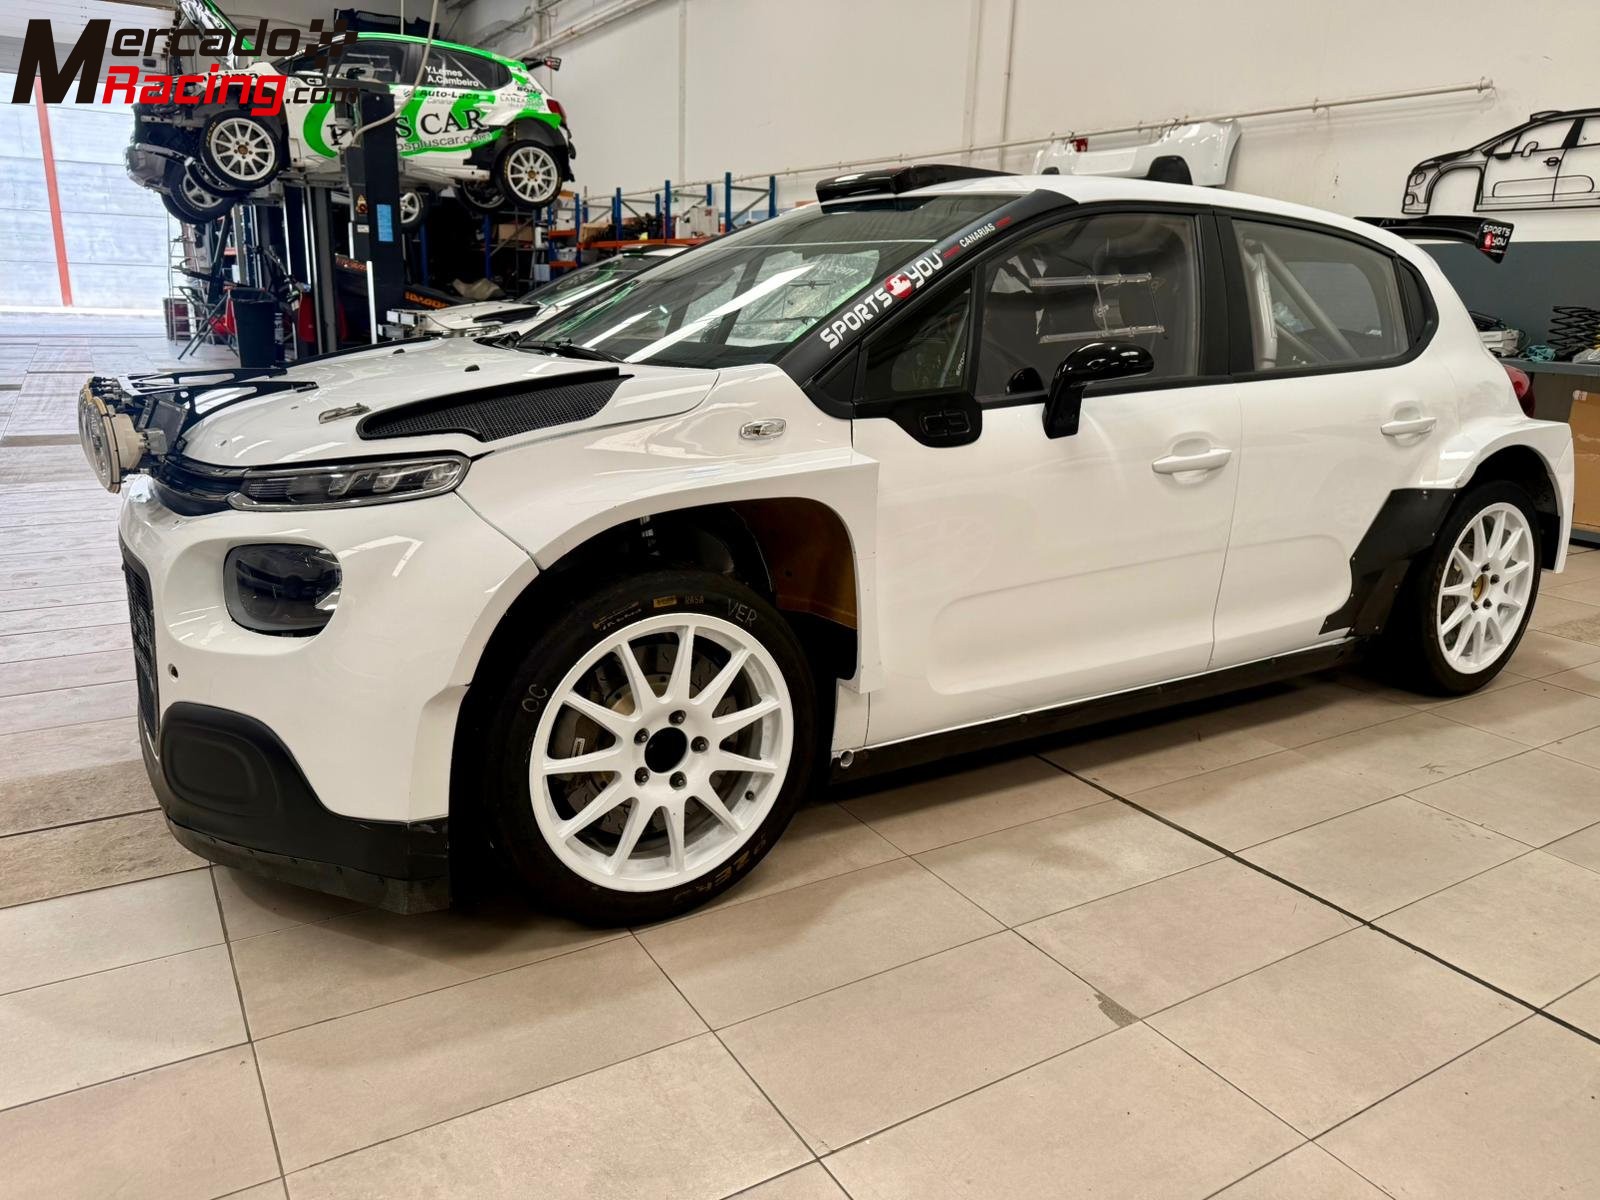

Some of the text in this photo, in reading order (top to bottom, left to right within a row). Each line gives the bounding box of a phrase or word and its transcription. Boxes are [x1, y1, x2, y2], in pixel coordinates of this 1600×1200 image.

[420, 109, 488, 136] CAR
[959, 222, 996, 248] CANARIAS
[1483, 225, 1511, 236] SPORTS
[728, 598, 758, 627] VER
